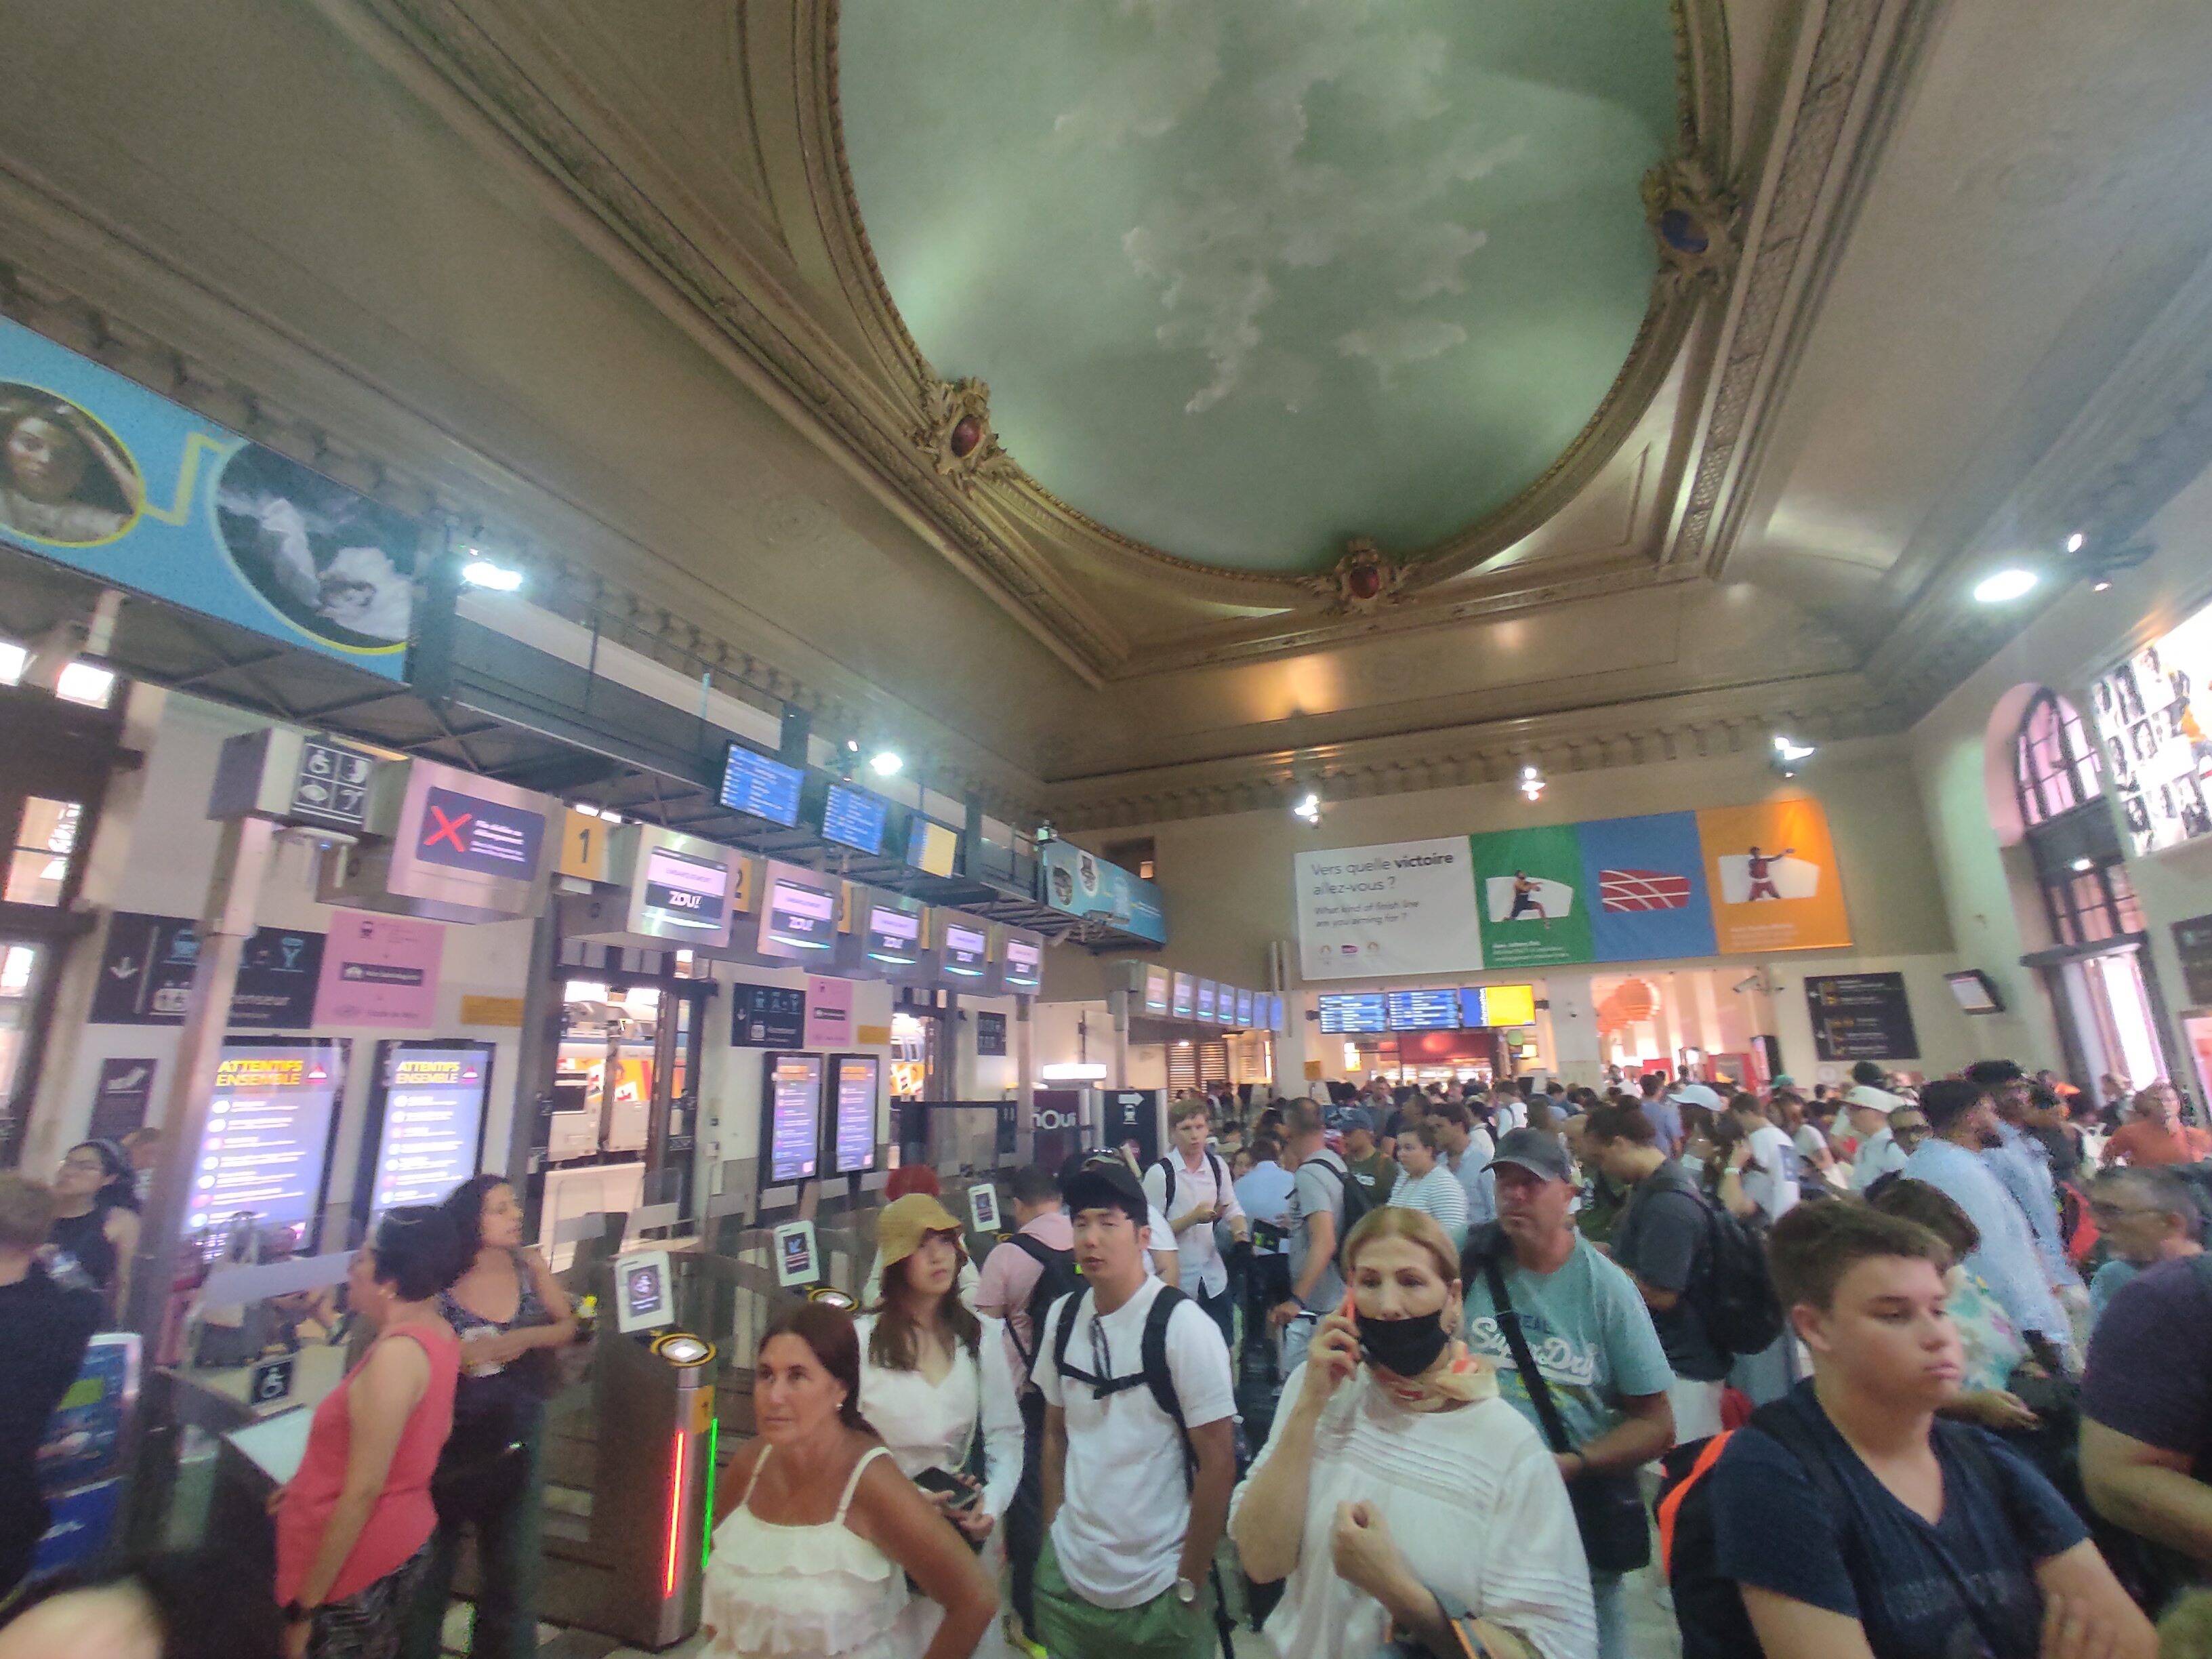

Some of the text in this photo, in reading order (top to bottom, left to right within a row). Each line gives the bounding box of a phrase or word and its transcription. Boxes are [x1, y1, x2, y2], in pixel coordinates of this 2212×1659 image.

[579, 828, 591, 863] 1
[1311, 852, 1454, 876] Vers quelle victoire
[1313, 880, 1385, 895] allez-vous
[218, 1059, 304, 1073] ATTENTIFS
[216, 1072, 301, 1086] ENSEMBLE
